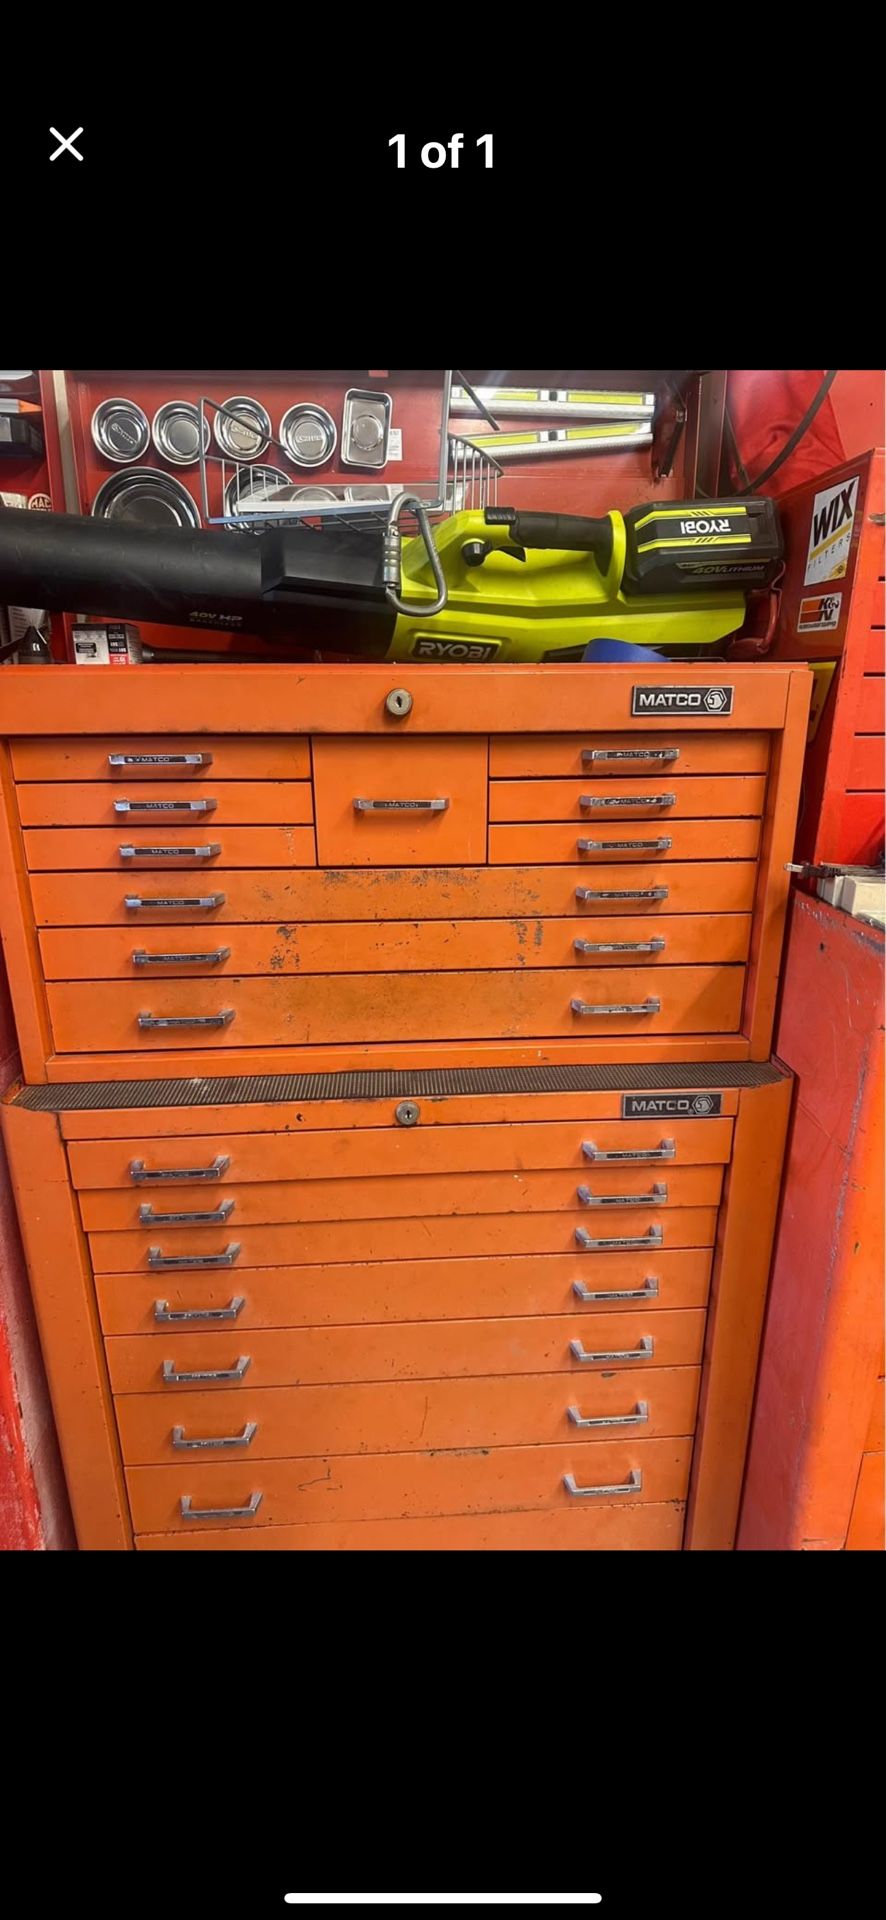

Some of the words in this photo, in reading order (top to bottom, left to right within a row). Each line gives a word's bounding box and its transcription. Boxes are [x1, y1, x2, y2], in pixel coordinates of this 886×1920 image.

[31, 496, 52, 508] MAC
[813, 478, 857, 548] WIX
[680, 519, 732, 535] RYOBI
[808, 532, 851, 570] FILTERS
[419, 641, 491, 660] RYOBI
[639, 693, 702, 707] MATCO
[146, 802, 174, 810] MATCO
[631, 1100, 690, 1112] MATCO
